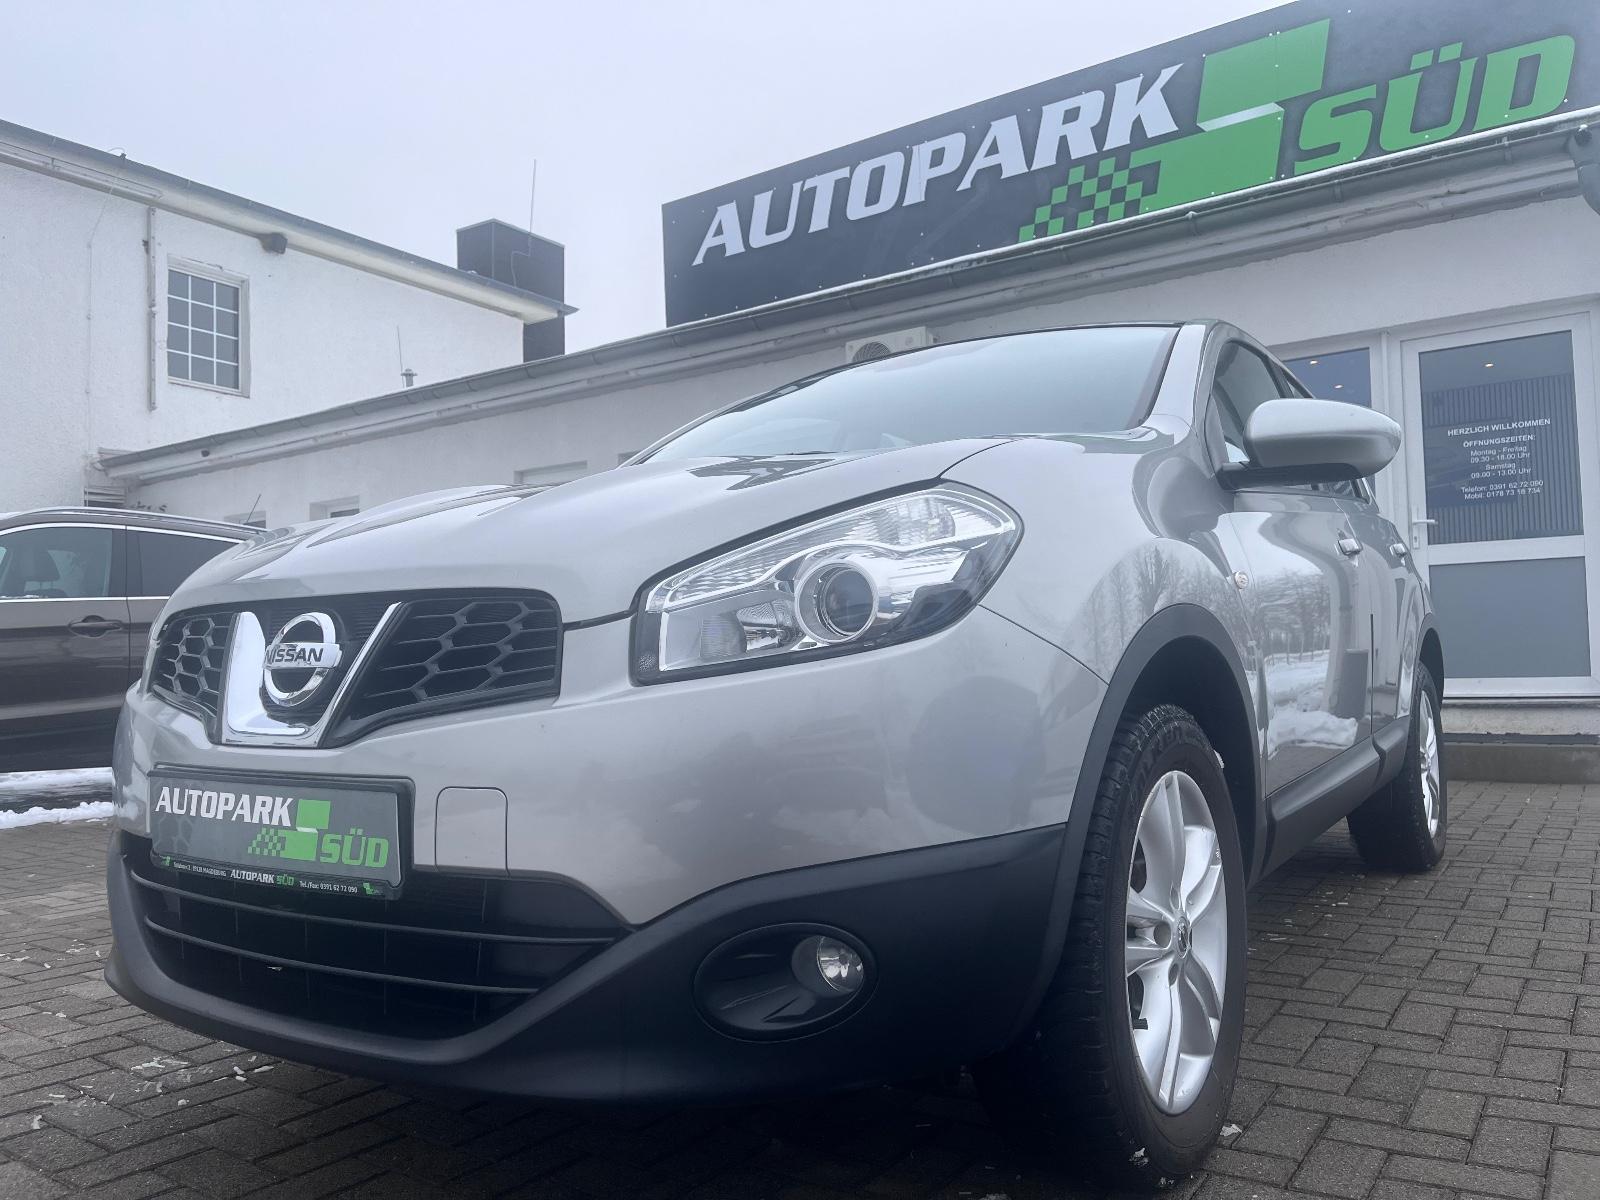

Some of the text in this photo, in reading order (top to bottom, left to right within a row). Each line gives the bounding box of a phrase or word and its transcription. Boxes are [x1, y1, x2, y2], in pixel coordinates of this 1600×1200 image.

[692, 35, 1575, 266] AUTOPARK SÜD
[1447, 418, 1551, 437] HERZLICH WILLKOMMEN
[1470, 449, 1497, 457] Montag
[1485, 463, 1516, 471] Samstag
[1490, 483, 1506, 491] 0391
[1464, 492, 1485, 500] Mobil:
[265, 647, 324, 665] NISSAN
[155, 786, 389, 868] AUTOPARK SÜD
[230, 869, 275, 884] AUTOPARK
[276, 874, 295, 886] SÜD
